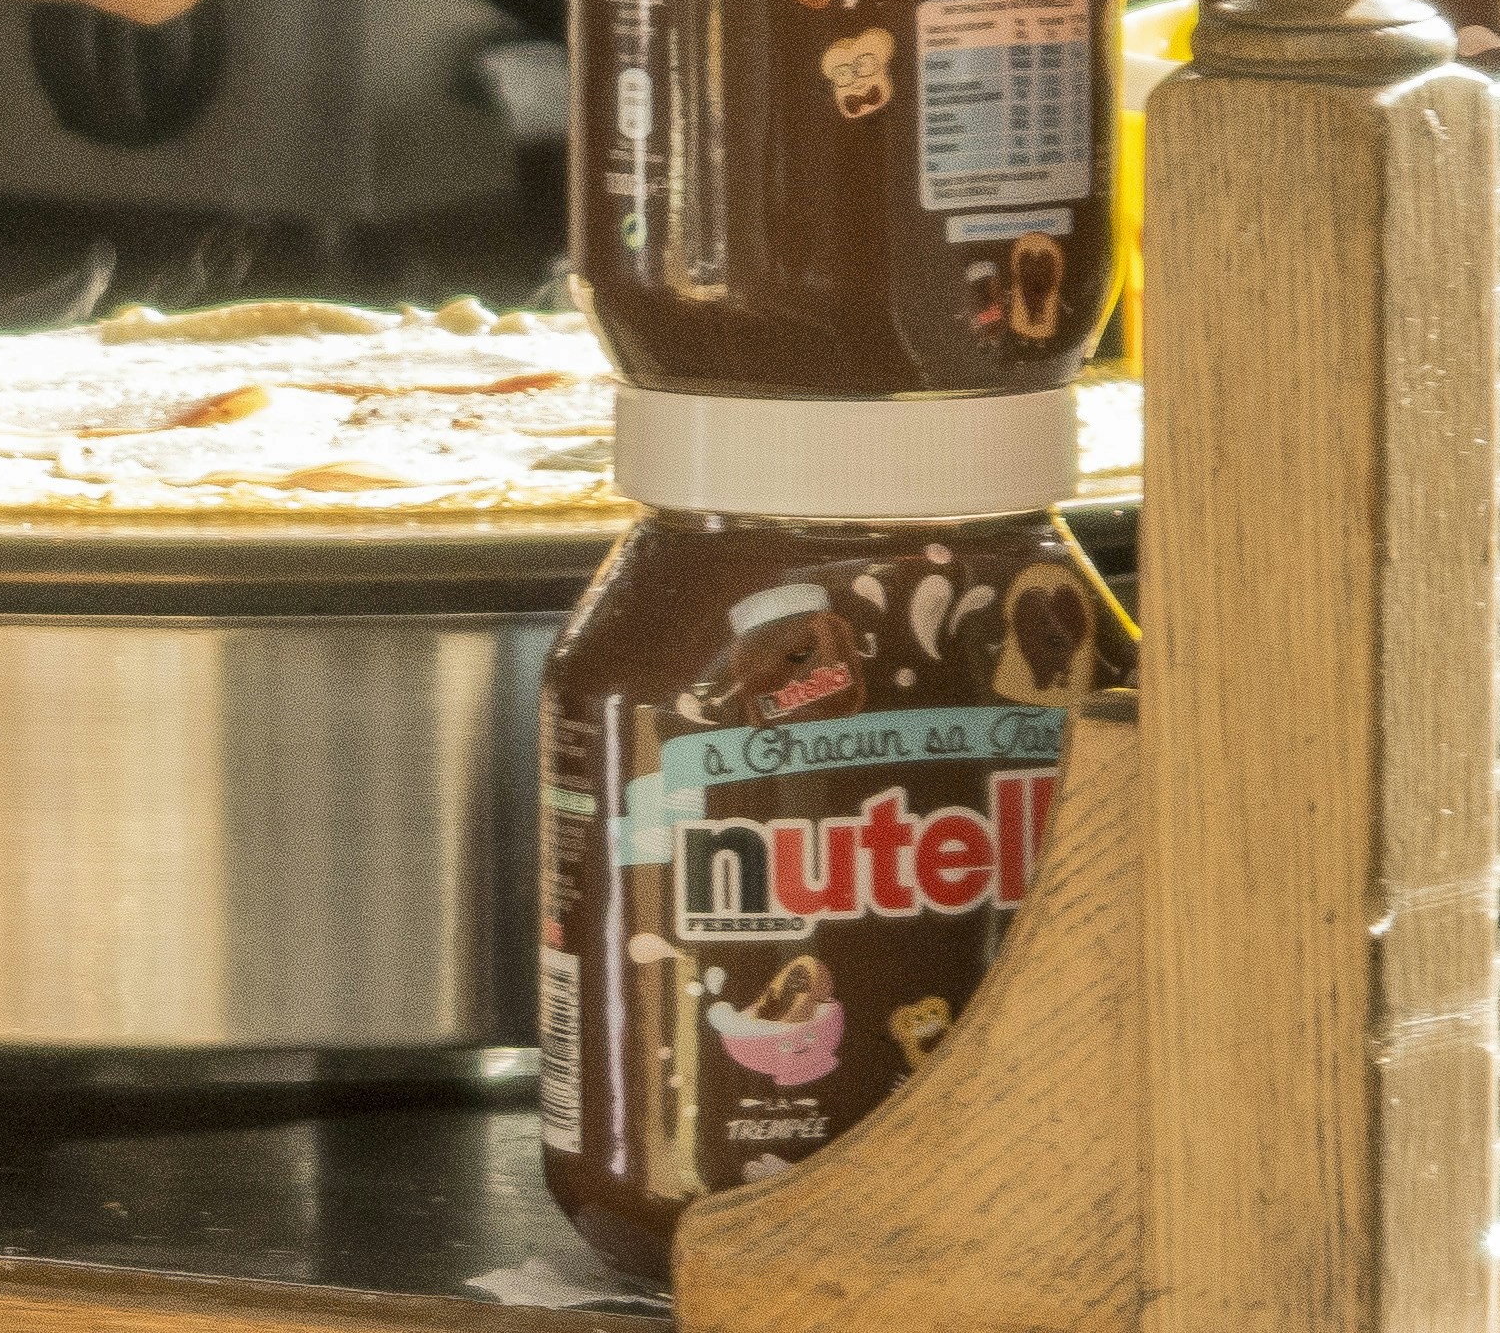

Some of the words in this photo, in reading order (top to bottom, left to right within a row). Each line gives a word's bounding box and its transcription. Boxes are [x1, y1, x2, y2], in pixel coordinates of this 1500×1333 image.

[743, 724, 911, 774] Chacun
[923, 724, 973, 757] sa
[686, 916, 805, 932] FERRERO
